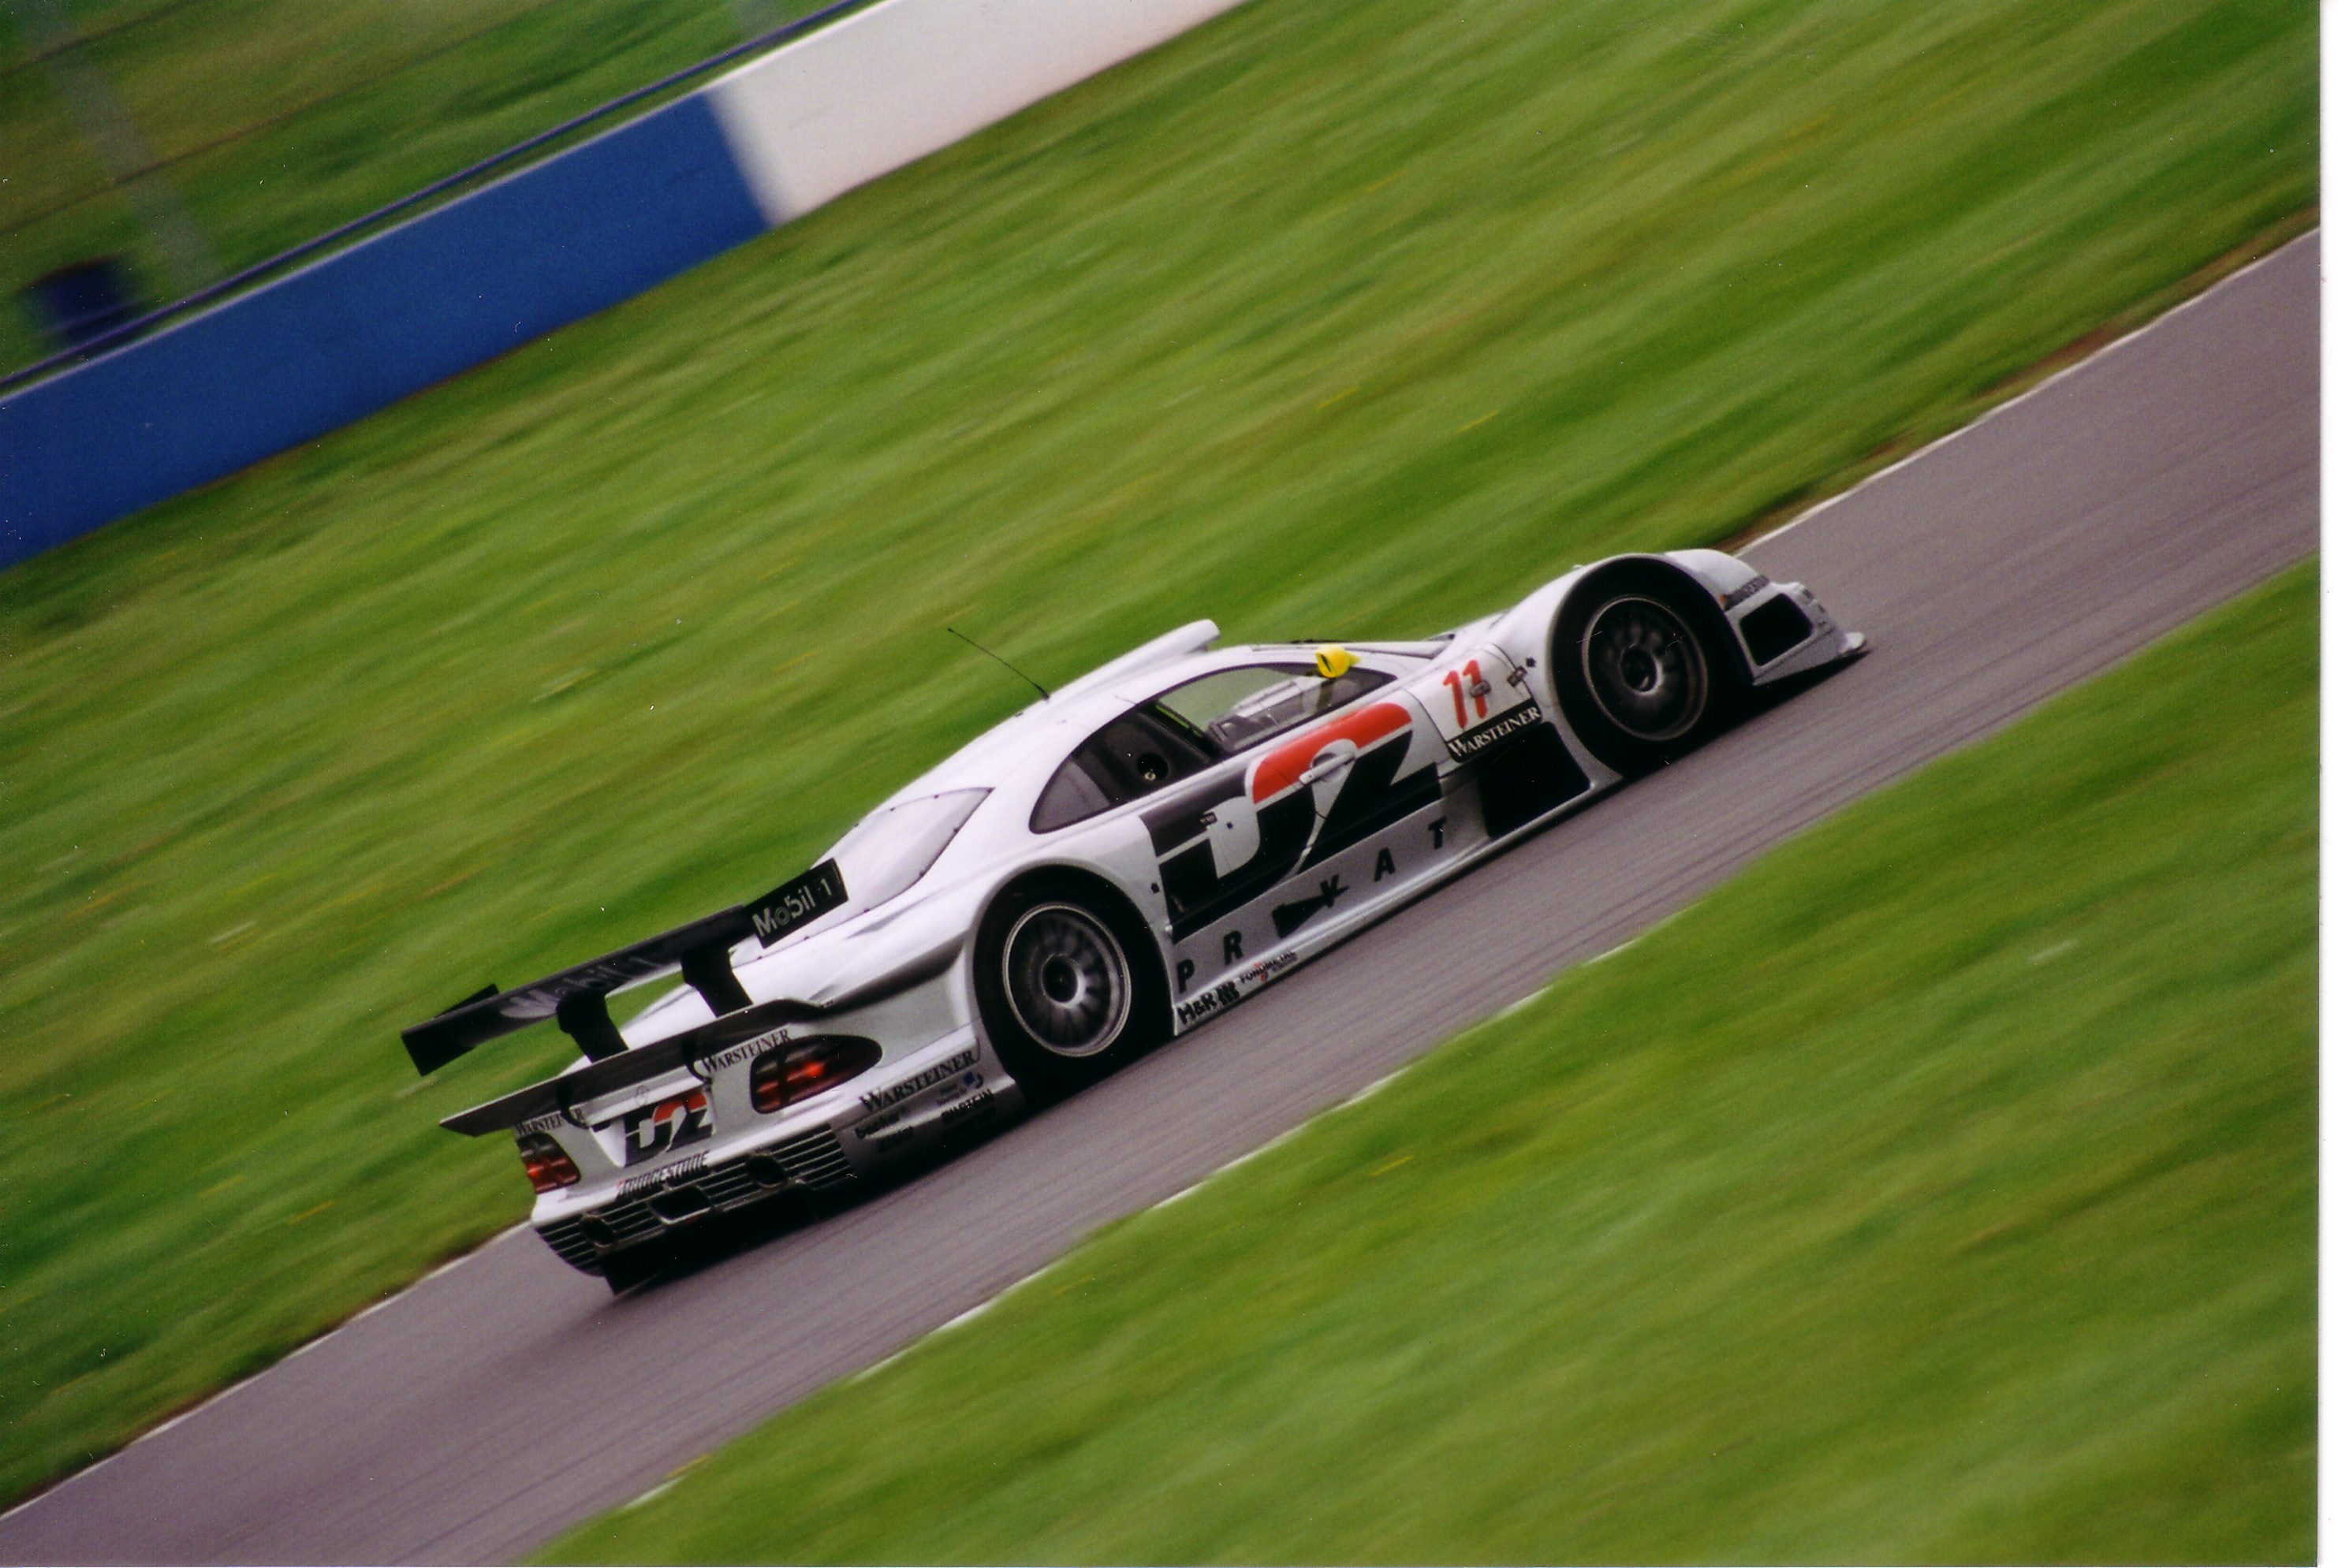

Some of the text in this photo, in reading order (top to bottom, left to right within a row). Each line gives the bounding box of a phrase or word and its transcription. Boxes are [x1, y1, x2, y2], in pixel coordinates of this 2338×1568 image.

[1443, 659, 1488, 729] 11
[1448, 706, 1541, 758] WARSTEINER
[1139, 702, 1443, 945] D2
[751, 877, 833, 937] Mobil 1
[1176, 817, 1448, 993] PRVAT
[701, 1028, 792, 1075] WARSTEINER
[859, 1051, 977, 1112] WARSTEINER
[516, 1108, 586, 1136] WARSTEIR
